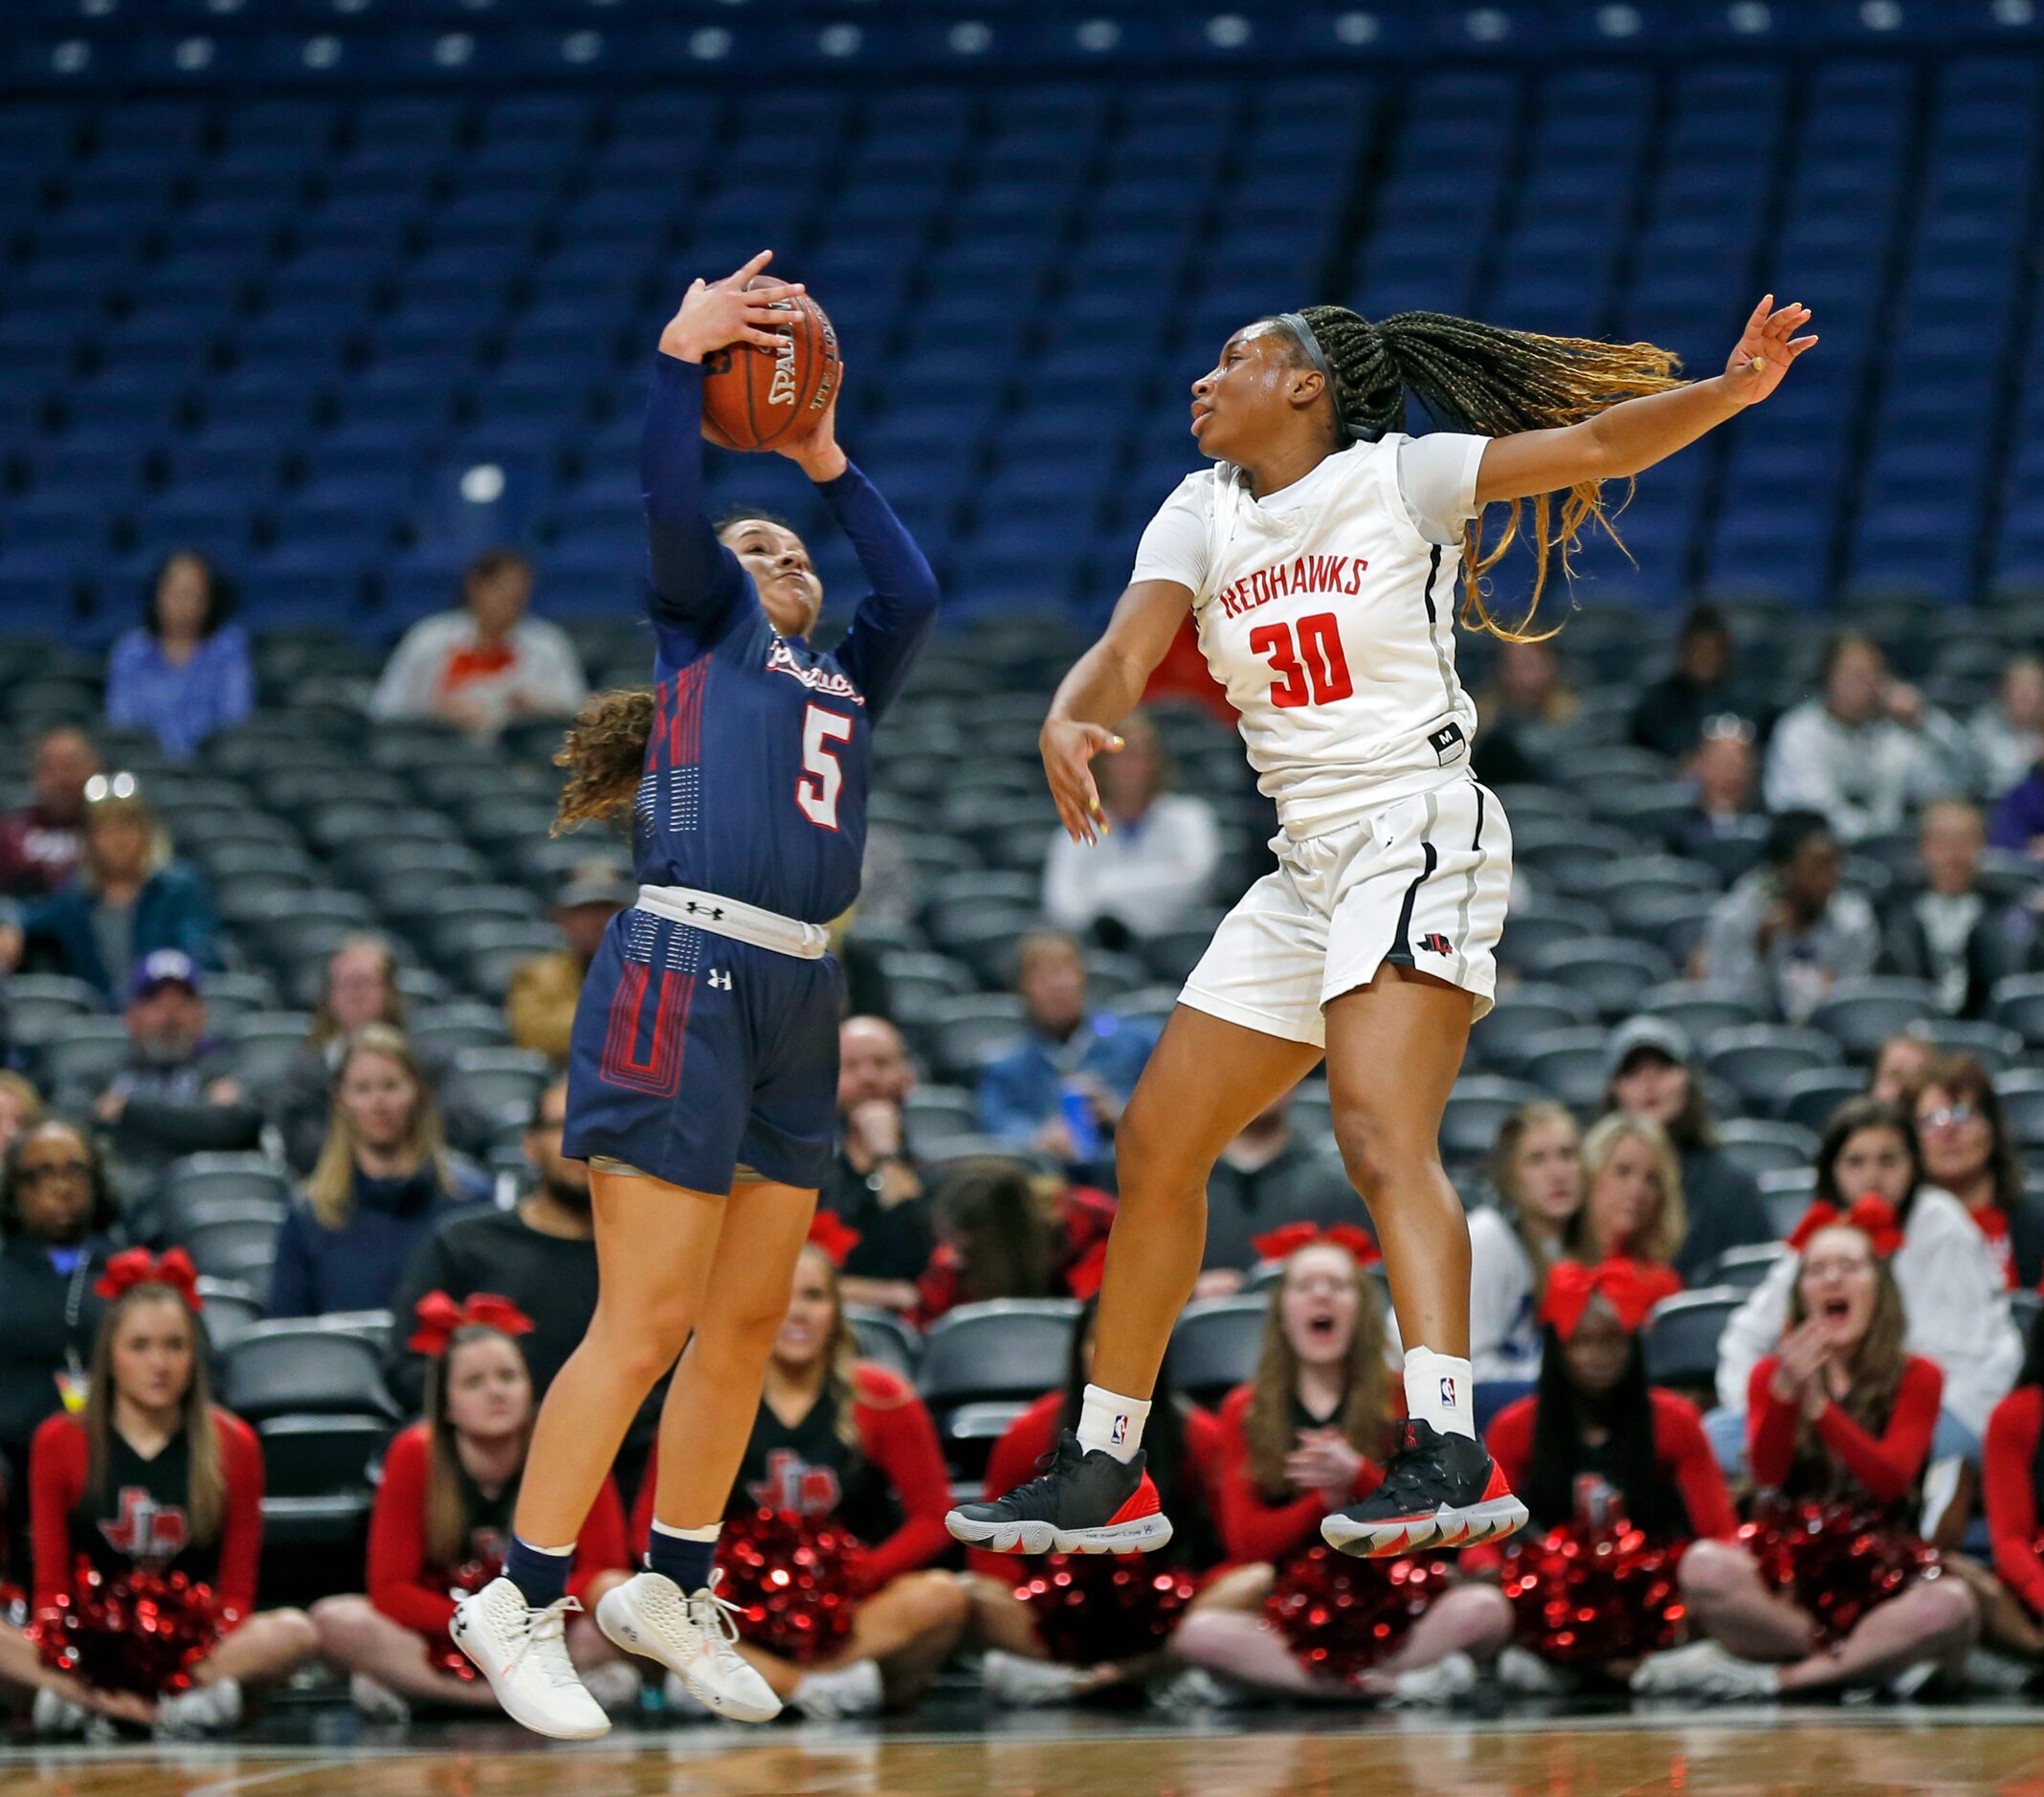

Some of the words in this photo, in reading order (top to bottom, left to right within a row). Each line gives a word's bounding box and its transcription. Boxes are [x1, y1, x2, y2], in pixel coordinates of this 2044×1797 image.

[768, 295, 796, 406] SPALD
[1219, 555, 1368, 619] REDHAWKS
[1249, 611, 1354, 709] 30
[795, 700, 855, 832] 5
[1438, 730, 1454, 745] M
